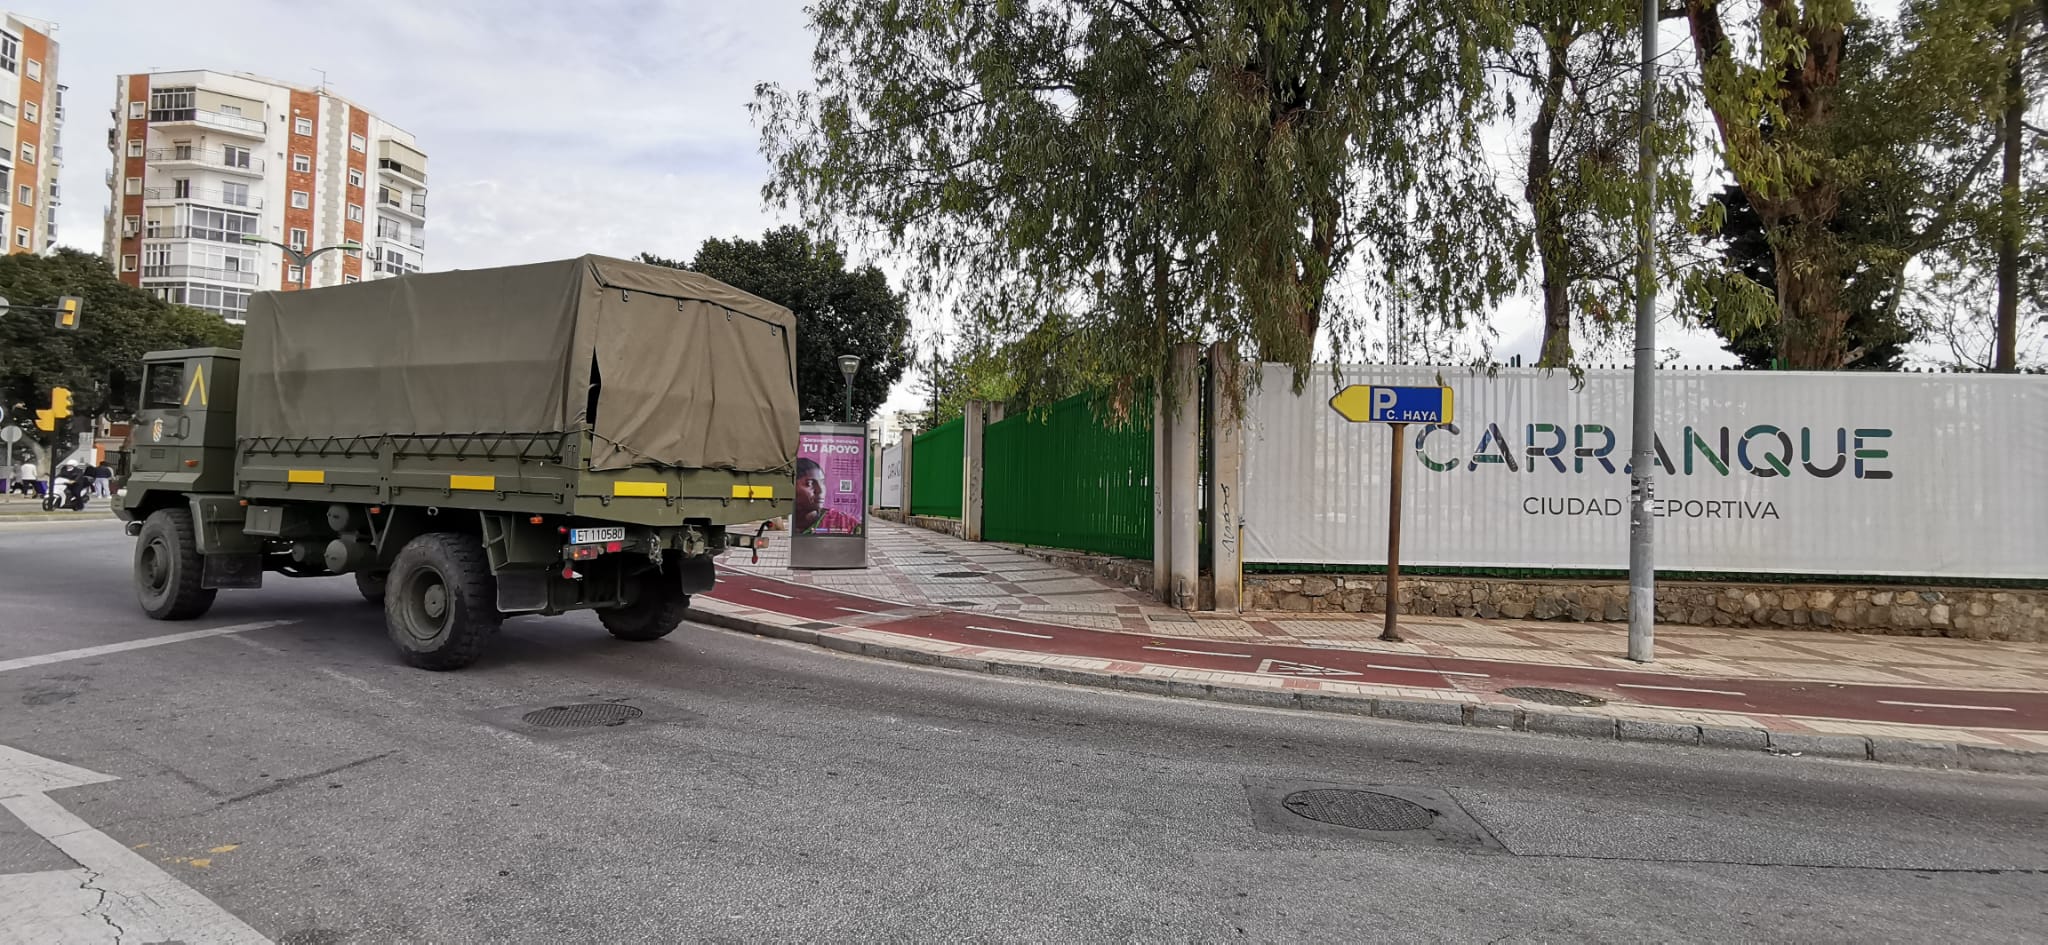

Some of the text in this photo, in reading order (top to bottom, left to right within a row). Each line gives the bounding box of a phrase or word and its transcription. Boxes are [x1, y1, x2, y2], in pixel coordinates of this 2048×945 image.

[1373, 387, 1398, 420] P
[1386, 410, 1438, 421] C. HAYA
[803, 444, 860, 454] TU APOYO
[1415, 422, 1893, 480] CARRANQUE
[1523, 496, 1780, 520] CIUDAD EPORTIVA
[577, 528, 623, 542] ET 110580
